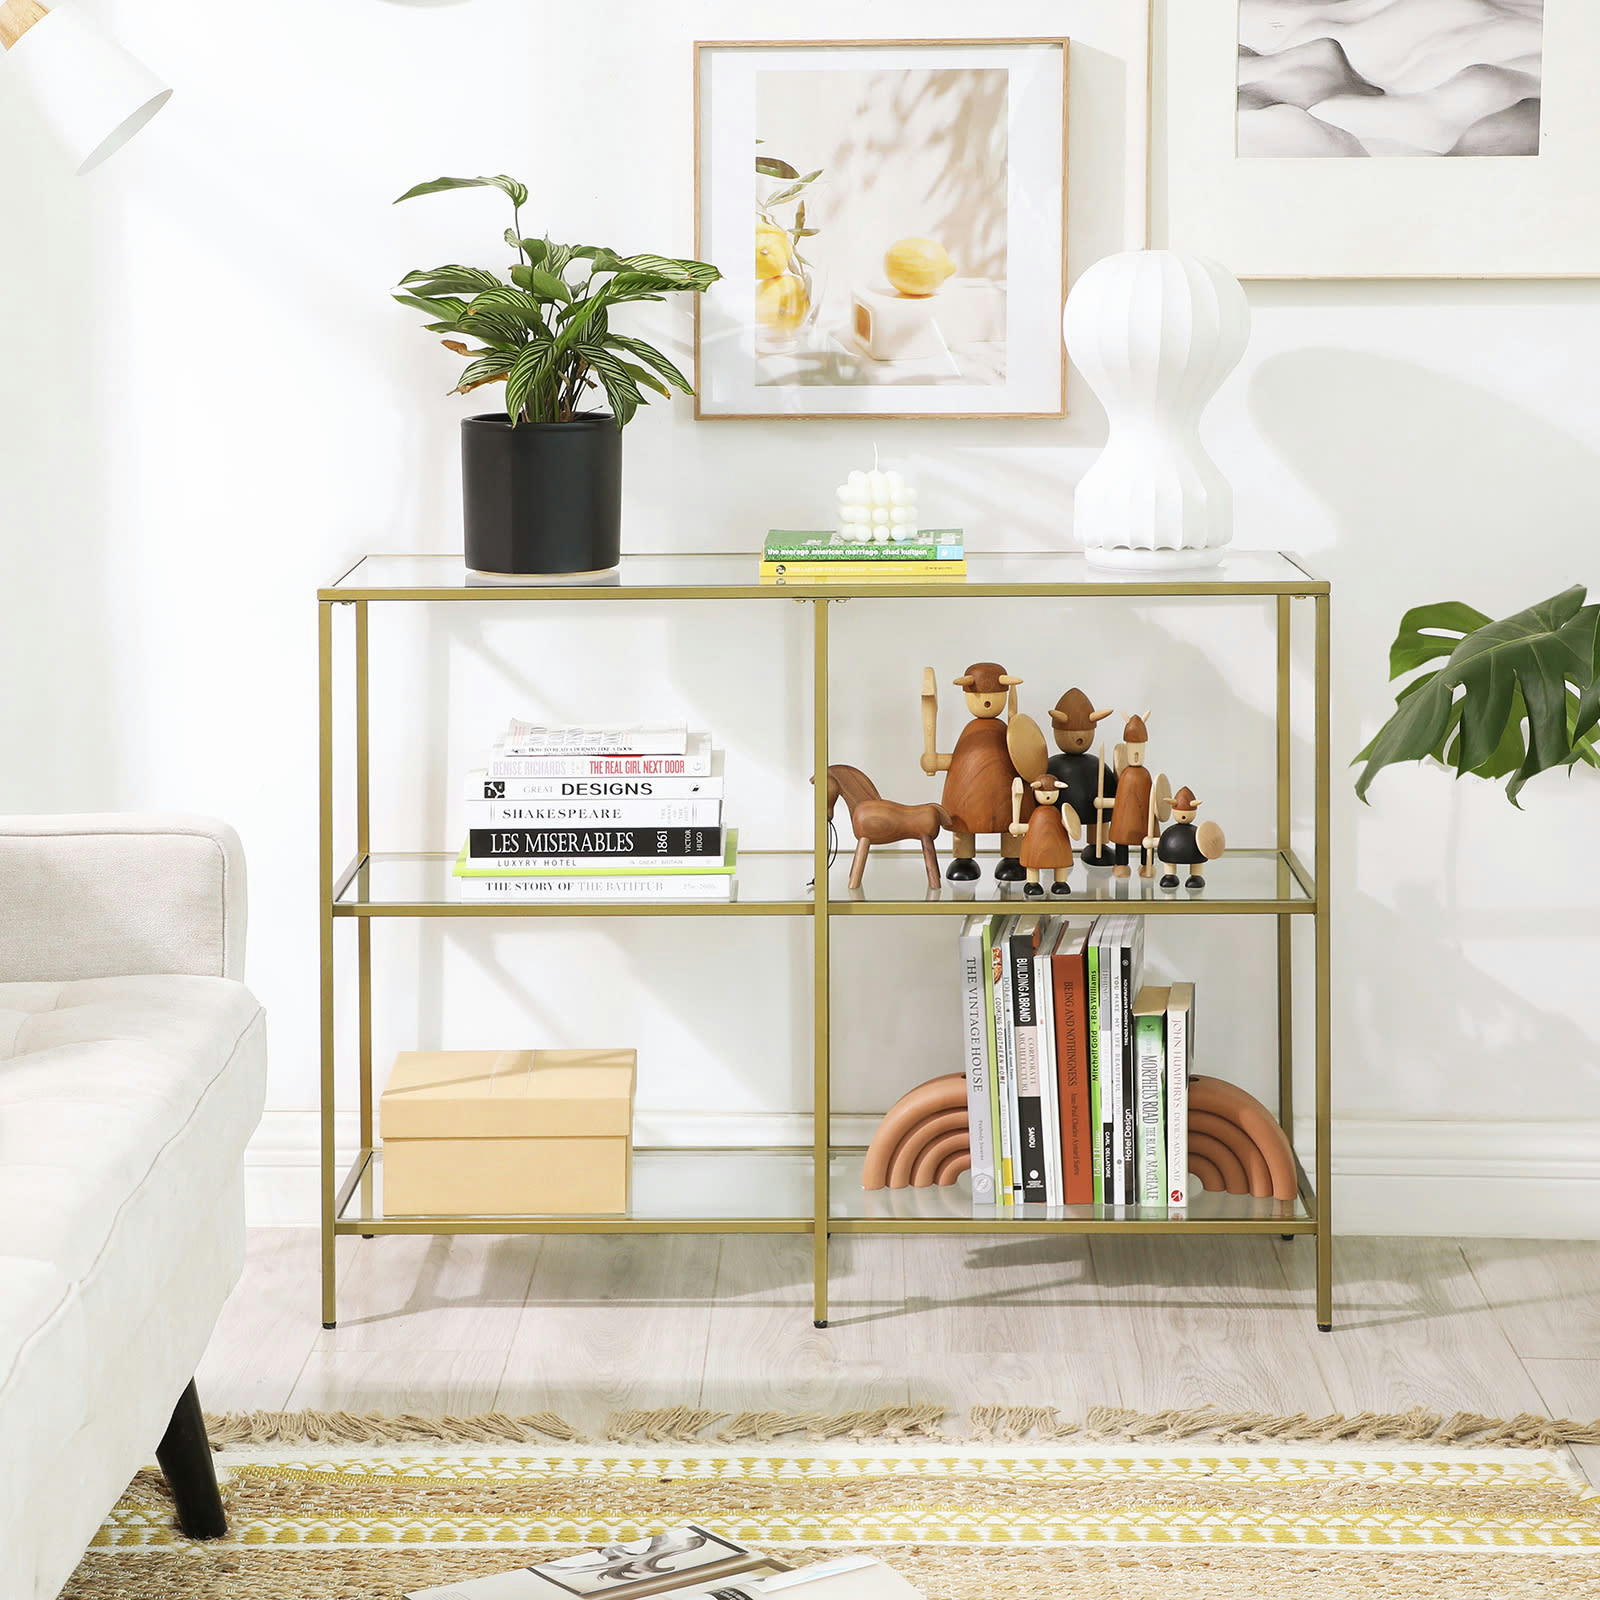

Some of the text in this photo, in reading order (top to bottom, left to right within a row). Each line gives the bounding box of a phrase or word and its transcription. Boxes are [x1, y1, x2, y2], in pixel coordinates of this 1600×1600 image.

[493, 761, 523, 776] DENISE
[525, 760, 566, 776] RICHARDS
[590, 763, 602, 774] THE
[604, 761, 623, 774] REAL
[624, 761, 641, 774] GIRL
[643, 760, 662, 774] NEXT
[664, 760, 684, 774] DOOR
[524, 783, 652, 796] GREAT DESIGNS
[502, 808, 622, 819] SHAKESPEARE
[491, 831, 634, 854] LES MISERABLES
[656, 830, 668, 853] 1861
[486, 881, 664, 891] THE STORY OF THE BATHTUB
[1015, 958, 1030, 991] BUILDING
[1090, 970, 1098, 1004] Williams
[1019, 998, 1032, 1022] BRAND
[966, 957, 982, 1093] THE VINTAGE HOUSE
[1064, 982, 1078, 1086] BEING AND NOTHINGNESS
[1018, 1032, 1037, 1092] CORPORATE ARCHITECTURE
[1090, 1050, 1098, 1082] Mitchell
[1171, 1018, 1182, 1108] JOHN HUMPHRYS
[1142, 1056, 1158, 1099] MORPHEUS
[1142, 1100, 1158, 1124] ROAD
[1028, 1127, 1036, 1148] SANDU
[1123, 1108, 1132, 1161] Hotel Design
[1146, 1126, 1156, 1137] THE
